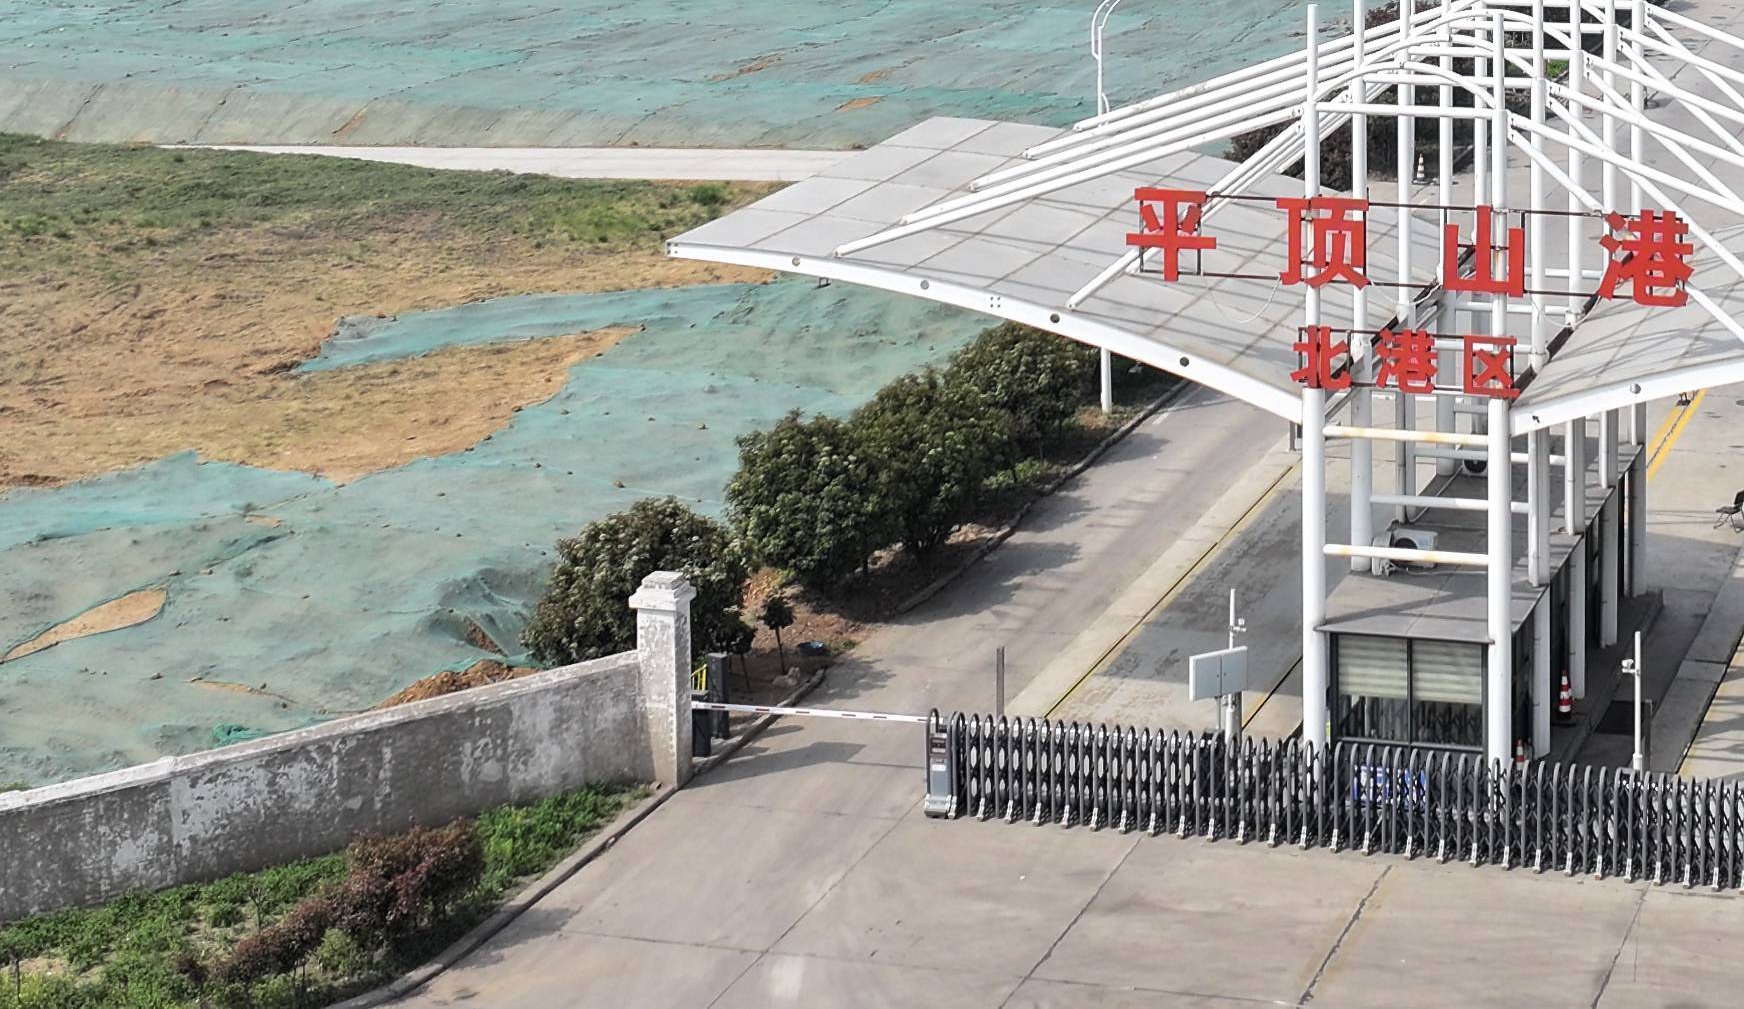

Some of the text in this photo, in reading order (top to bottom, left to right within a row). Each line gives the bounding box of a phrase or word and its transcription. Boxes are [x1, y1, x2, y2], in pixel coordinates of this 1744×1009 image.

[1126, 187, 1694, 306] 平顶山港
[1290, 325, 1520, 399] 北港区
